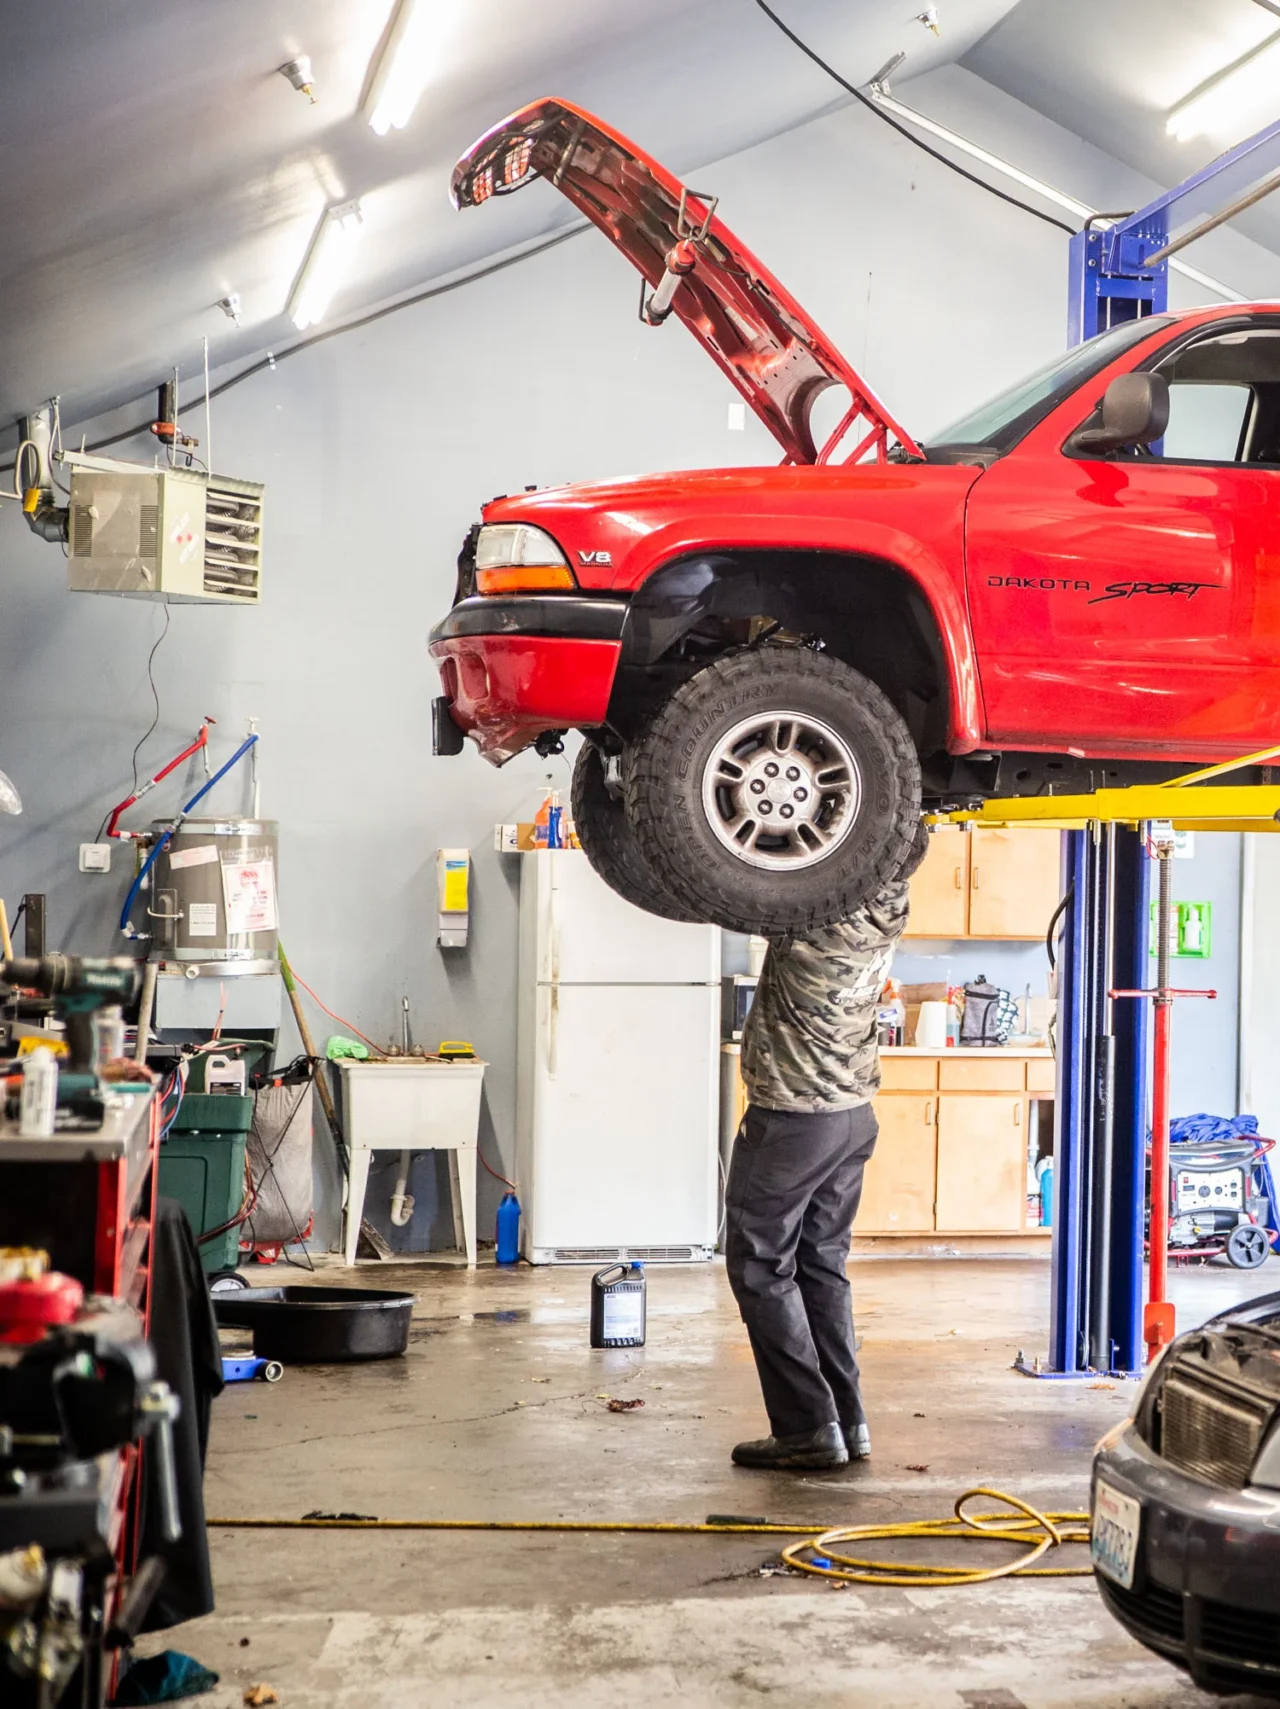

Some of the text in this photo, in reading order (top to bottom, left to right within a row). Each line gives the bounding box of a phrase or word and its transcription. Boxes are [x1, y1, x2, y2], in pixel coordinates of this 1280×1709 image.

[578, 551, 611, 562] V8
[988, 576, 1228, 604] DAKOTA SPORT
[677, 683, 779, 782] COUNTRY
